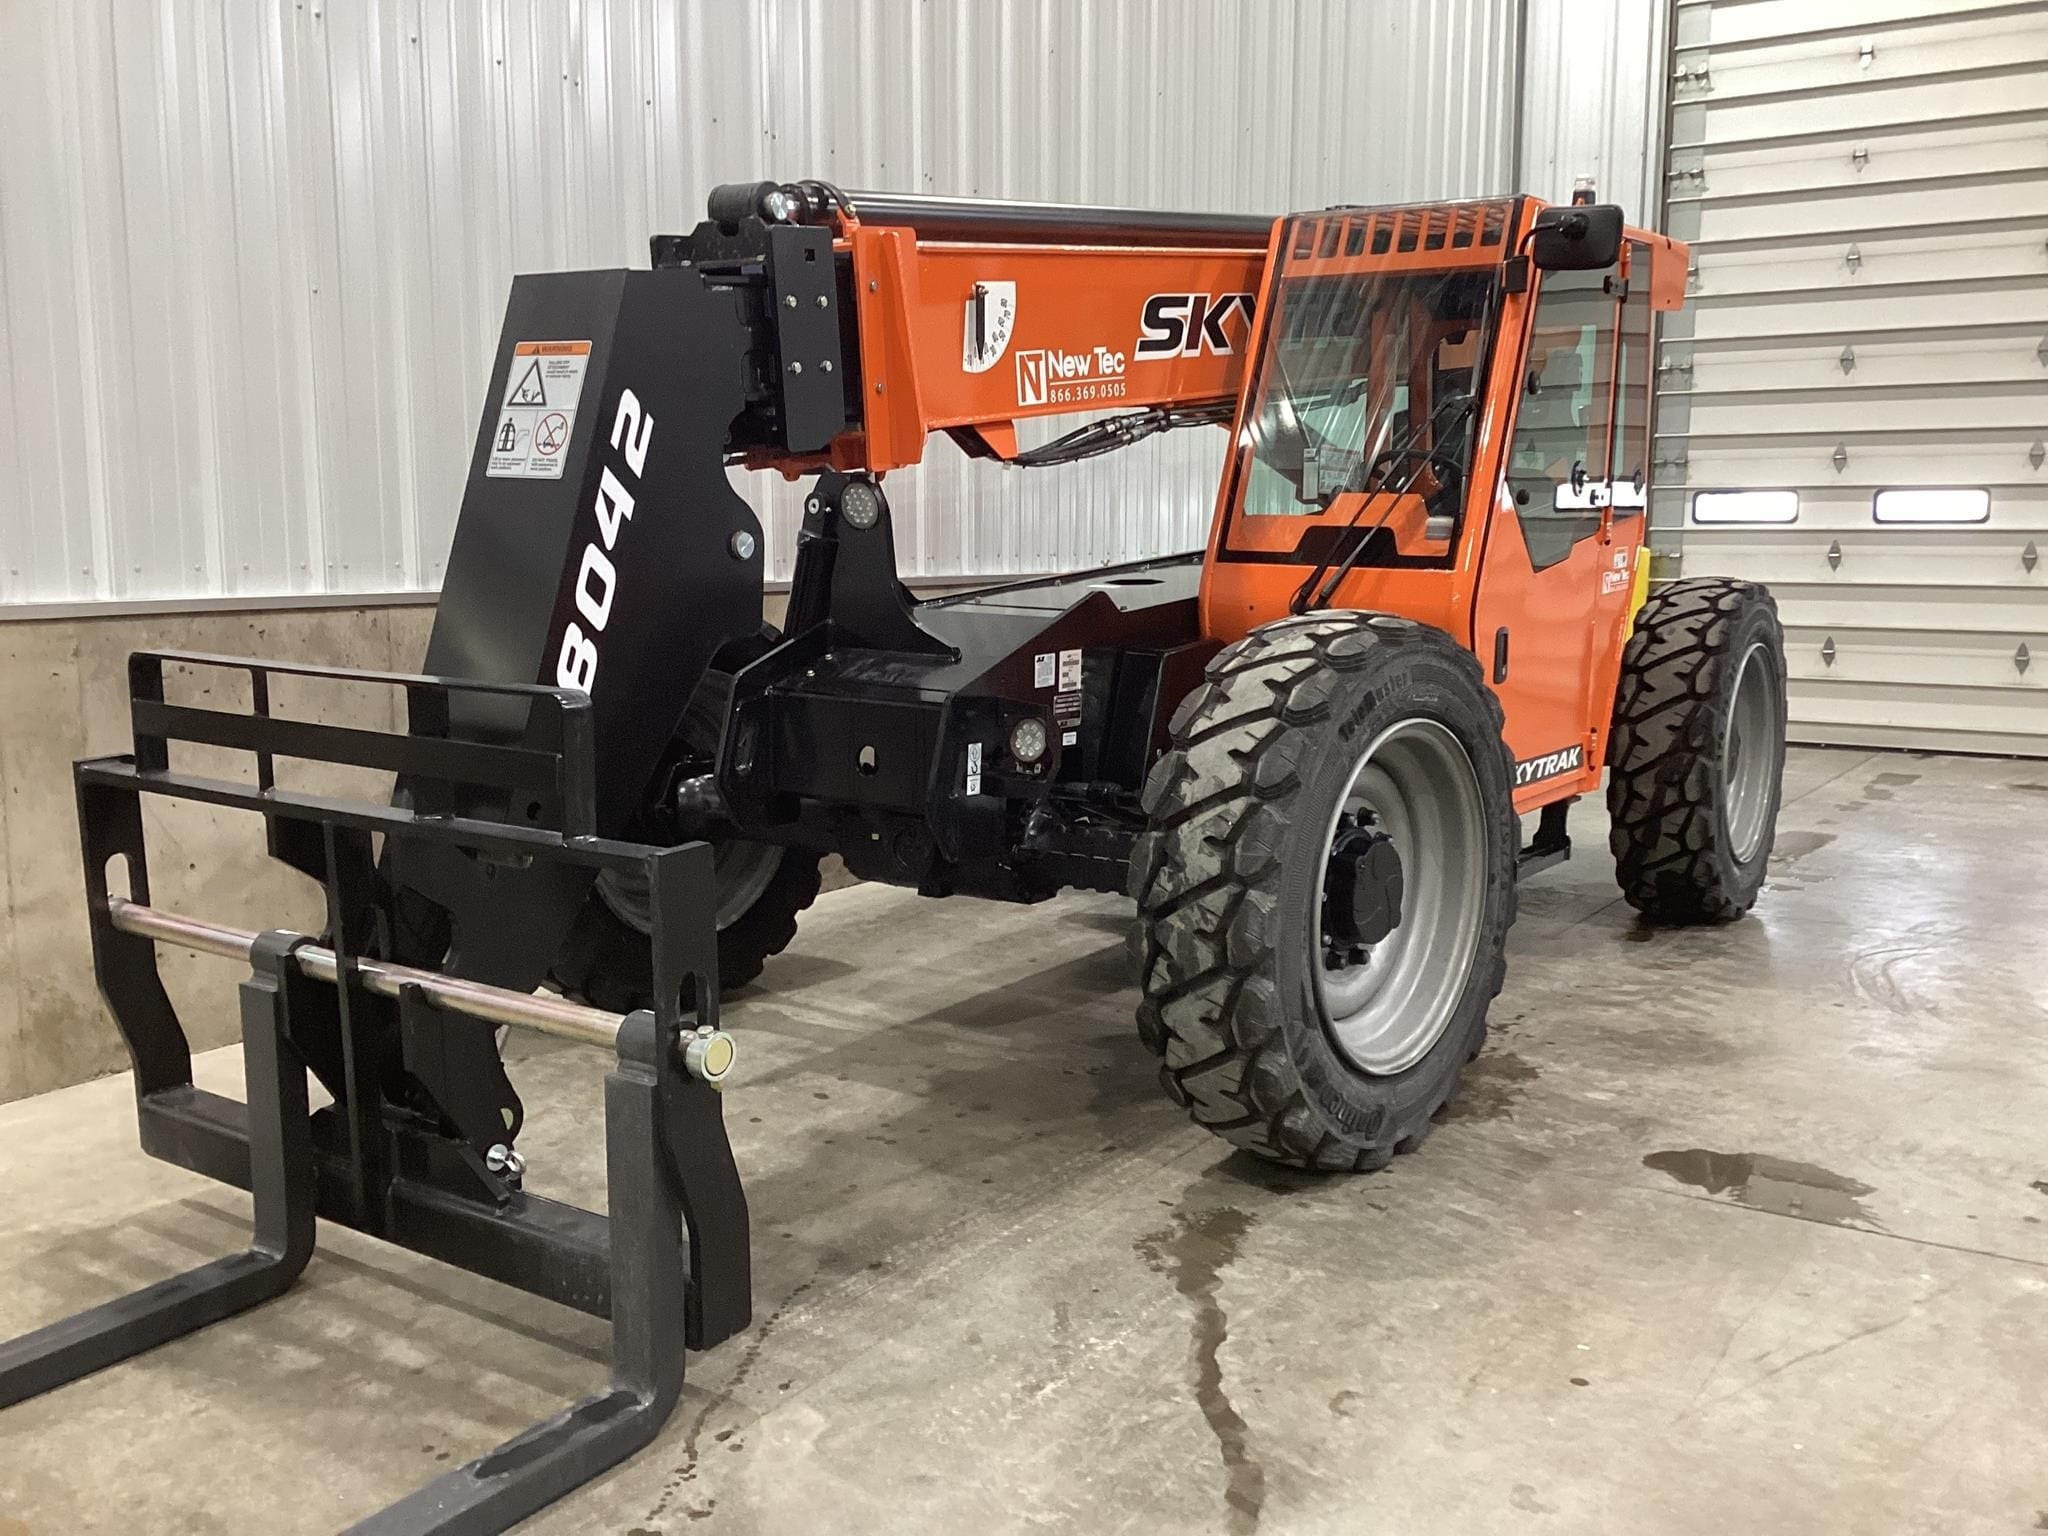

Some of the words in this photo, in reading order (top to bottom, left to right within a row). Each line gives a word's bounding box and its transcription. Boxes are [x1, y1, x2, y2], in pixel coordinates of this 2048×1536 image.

[1047, 349, 1091, 379] New
[1093, 346, 1126, 375] Tec
[1049, 382, 1127, 403] 866.369.0505
[556, 388, 654, 697] 8042
